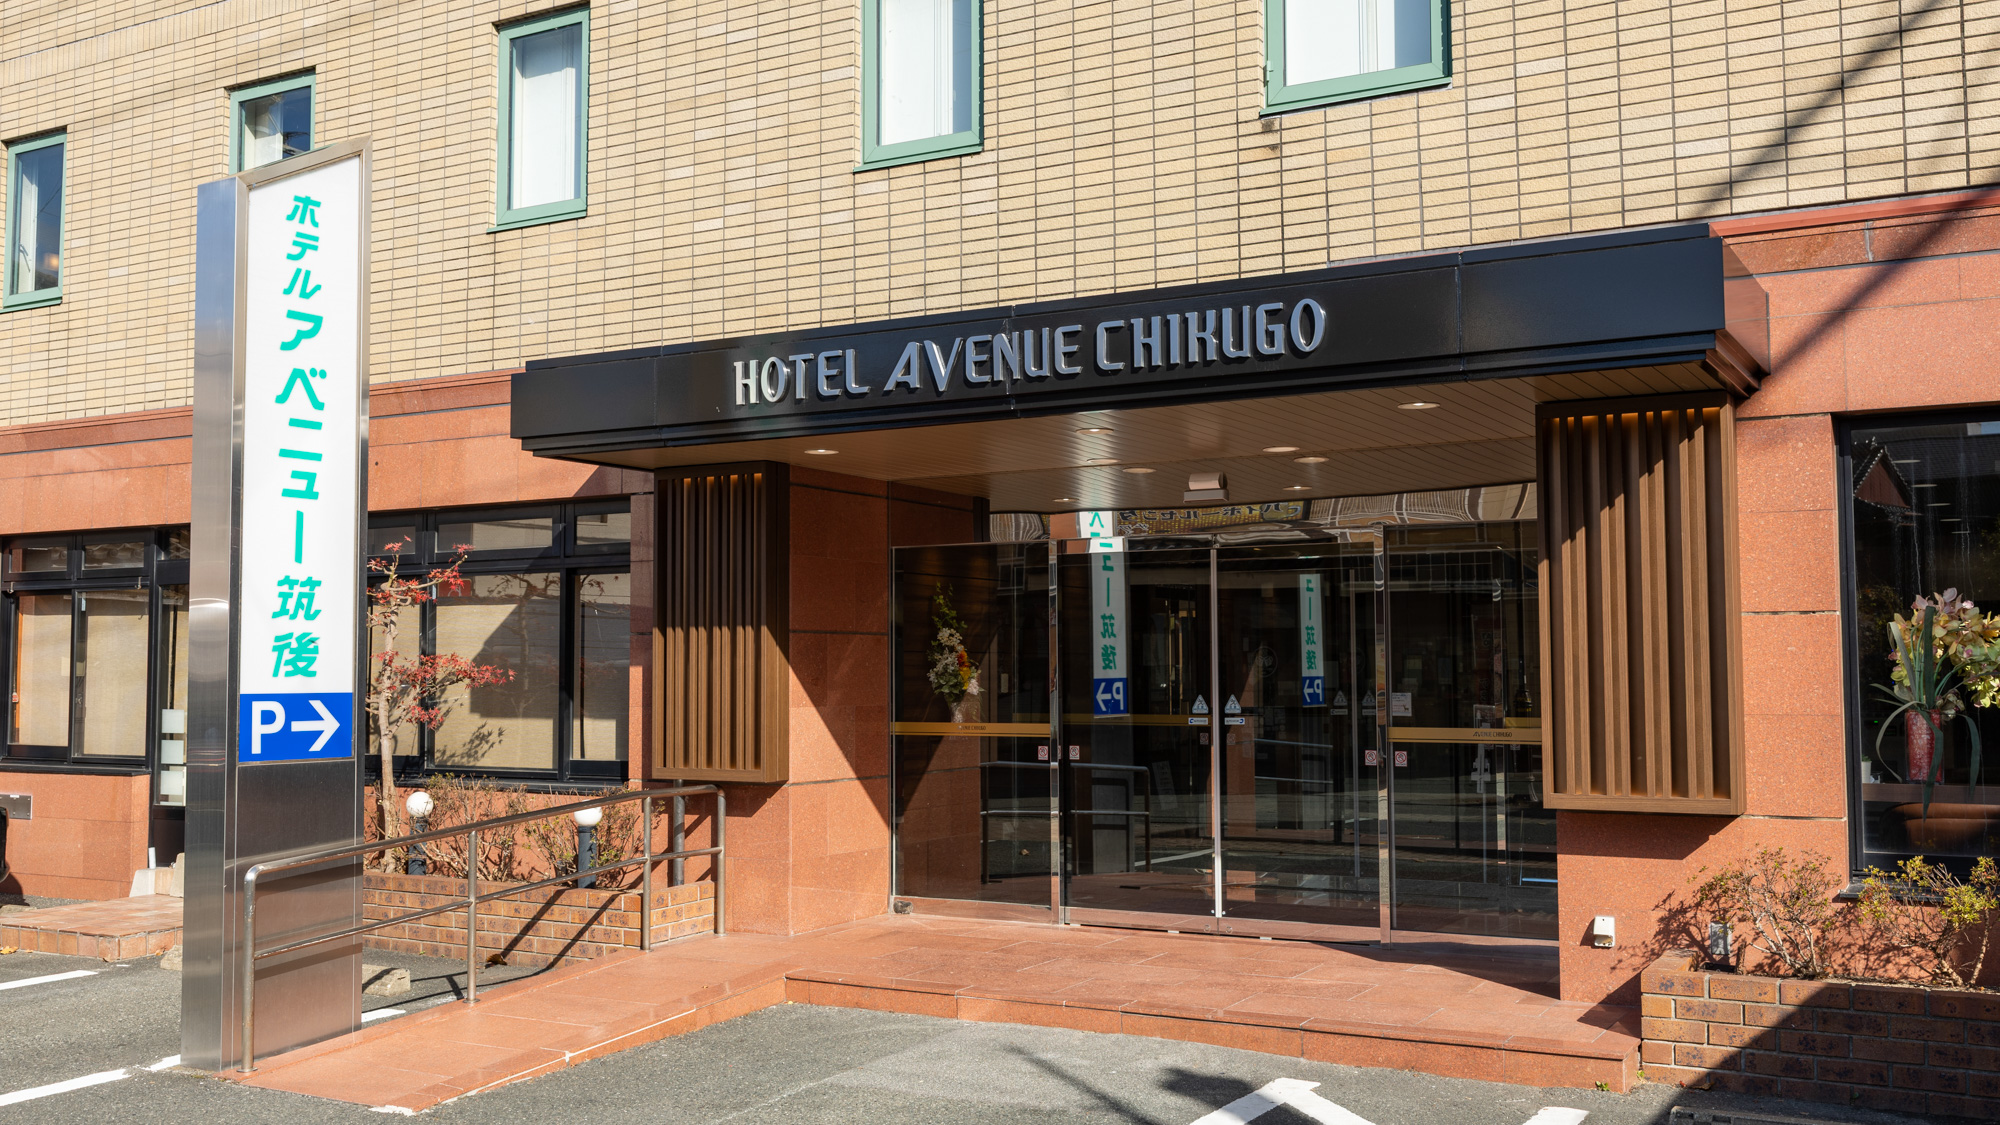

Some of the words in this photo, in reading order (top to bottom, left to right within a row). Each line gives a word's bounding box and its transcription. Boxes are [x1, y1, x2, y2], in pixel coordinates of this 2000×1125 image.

[734, 348, 872, 405] HOTEL
[884, 324, 1083, 392] AVENUE
[1097, 298, 1326, 370] CHIKUGO
[272, 195, 328, 677] ホテルアベニュー筑後
[251, 700, 286, 755] P
